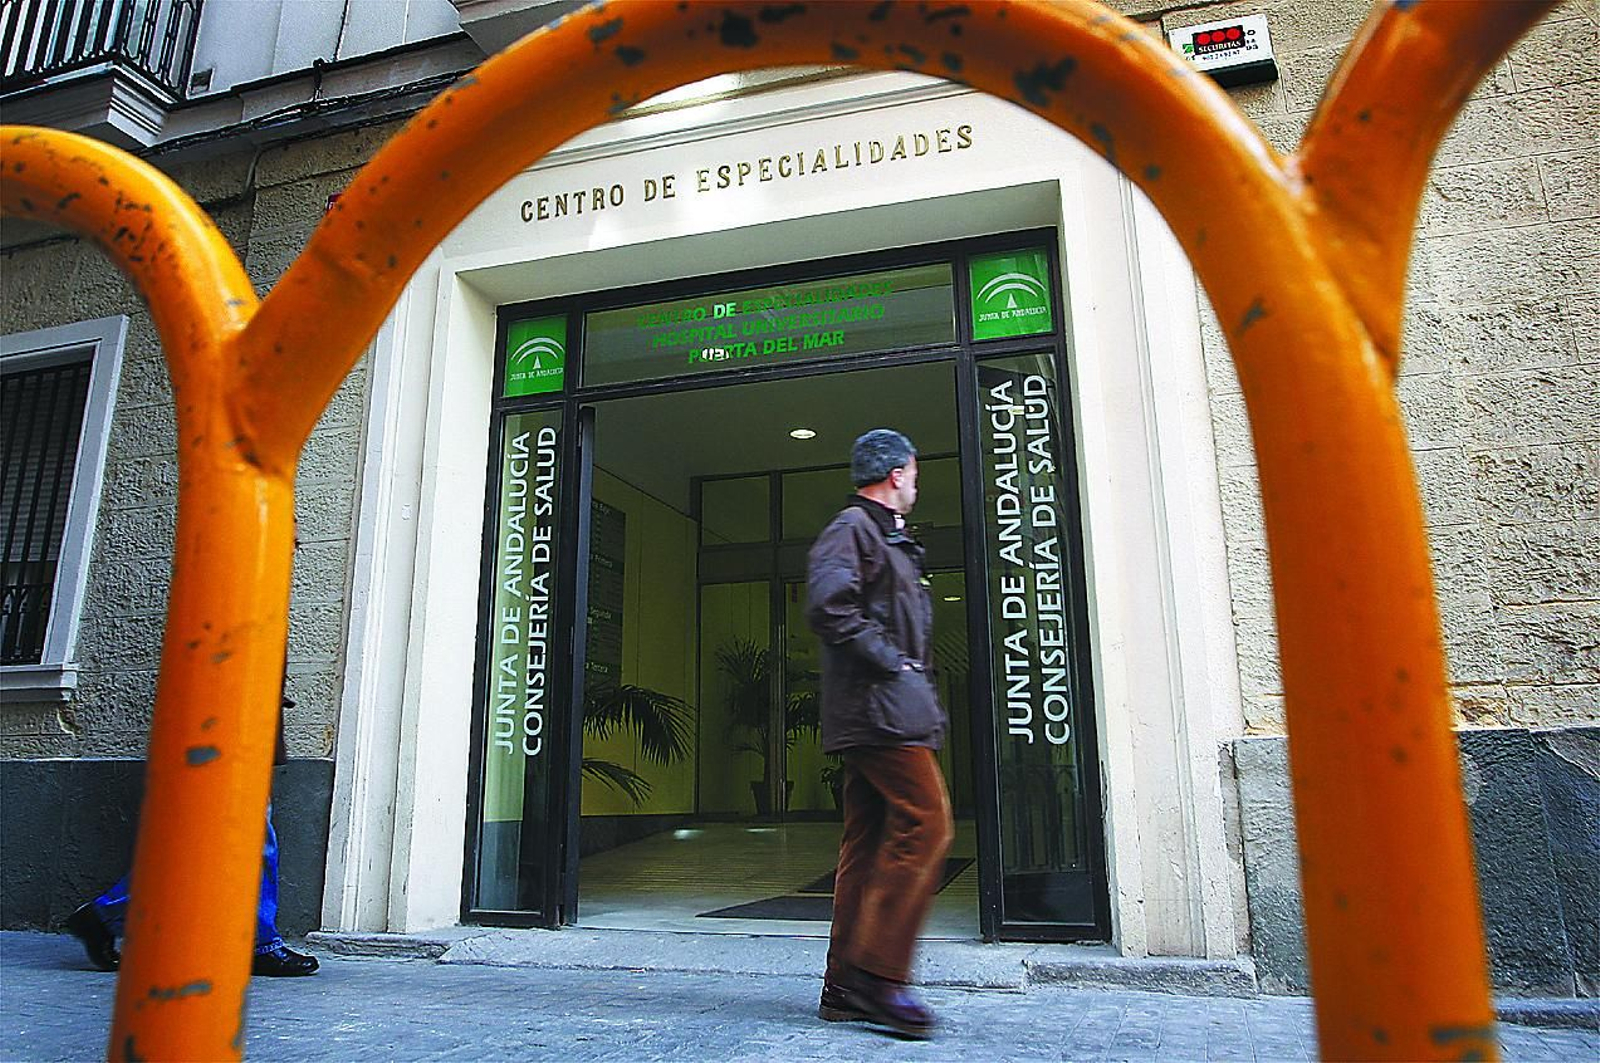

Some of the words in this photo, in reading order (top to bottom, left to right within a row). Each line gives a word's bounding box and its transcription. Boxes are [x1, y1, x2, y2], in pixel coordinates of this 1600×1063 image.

[1198, 41, 1241, 53] SECURITAS
[521, 183, 624, 223] CENTRO
[644, 174, 676, 202] DE
[696, 124, 973, 192] ESPECIALIDADES
[638, 307, 706, 329] CENTRO
[713, 302, 737, 320] DE
[652, 324, 738, 348] HOSPITAL
[742, 303, 886, 336] UNIVERSITARIO
[688, 342, 759, 364] PUERTA
[763, 334, 798, 354] DEL
[803, 330, 846, 350] MAR
[1001, 310, 1010, 319] DE
[1024, 375, 1053, 474] SALUD
[534, 427, 557, 516] SALUD
[985, 380, 1024, 566] ANDALUCÍA
[503, 431, 530, 597] ANDALUCÍA
[1030, 485, 1057, 527] DE
[532, 526, 552, 563] DE
[500, 606, 521, 644] DE
[1001, 576, 1027, 619] DE
[522, 572, 550, 756] CONSEJERÍA
[1029, 537, 1070, 745] CONSEJERÍA
[495, 653, 519, 754] JUNTA
[1003, 628, 1034, 744] JUNTA
